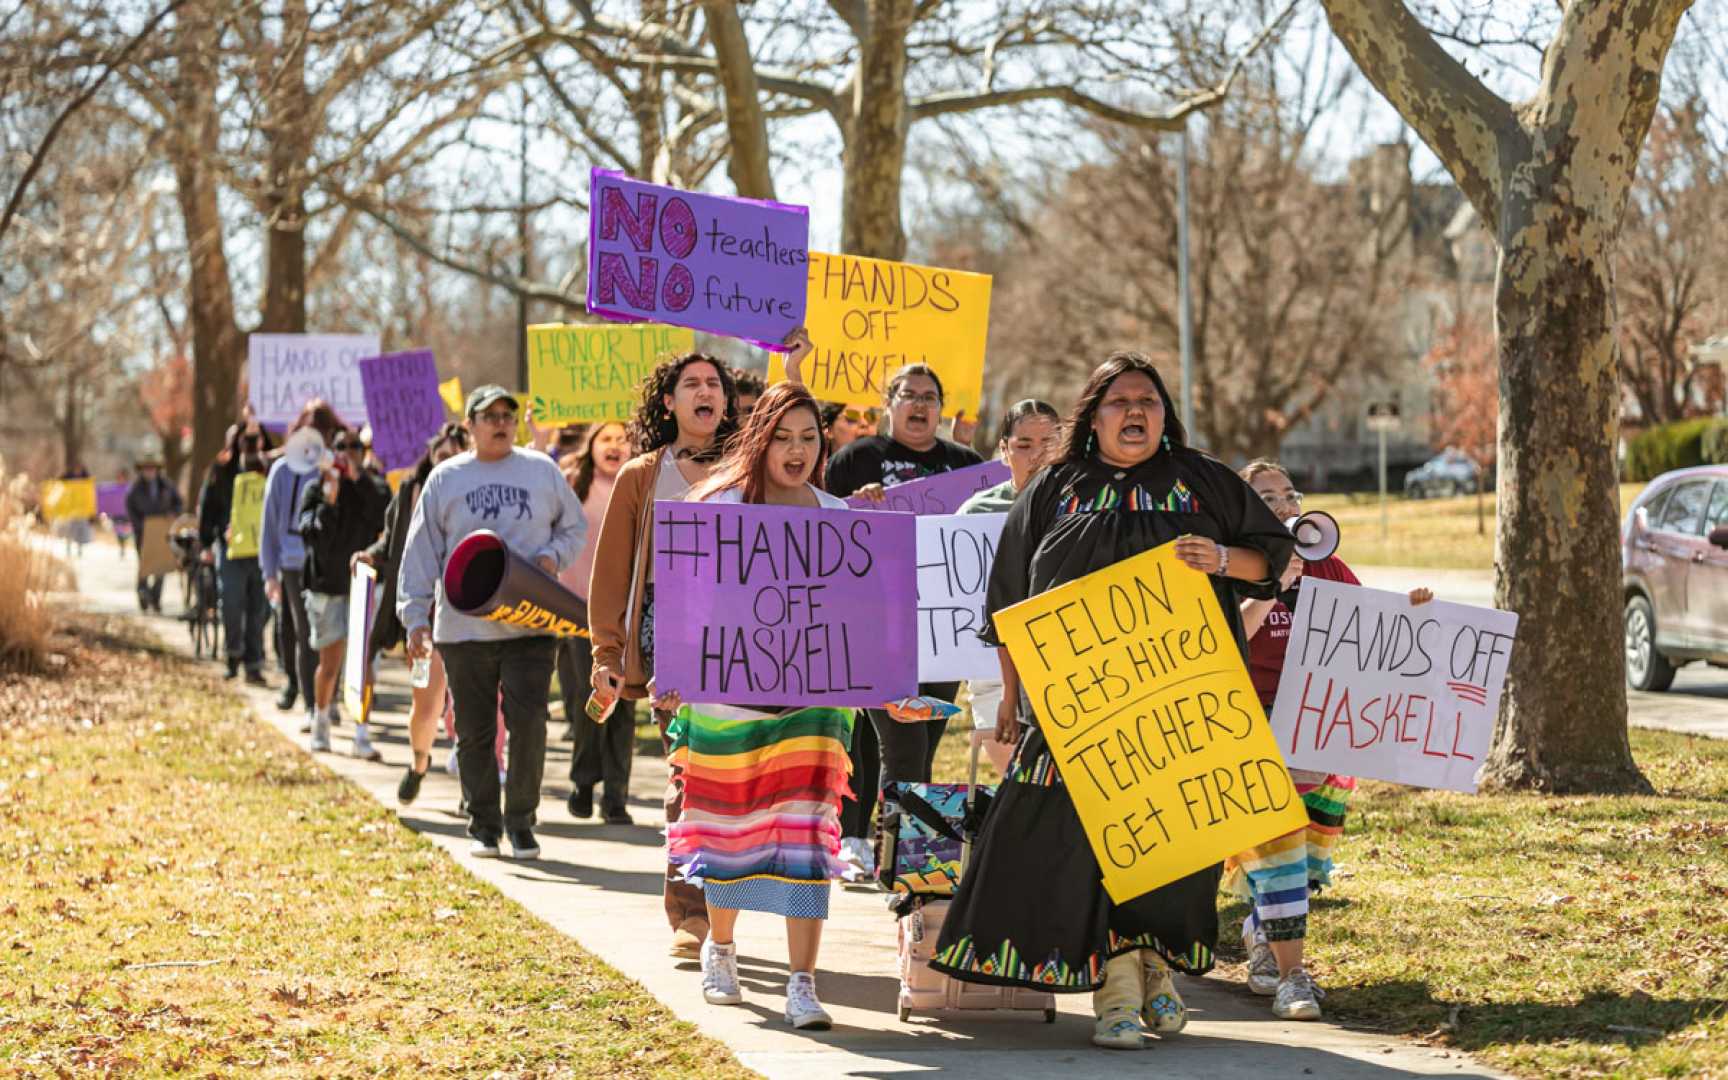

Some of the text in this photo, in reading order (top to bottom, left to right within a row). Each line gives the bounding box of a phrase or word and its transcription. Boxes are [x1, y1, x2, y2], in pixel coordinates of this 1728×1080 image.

[599, 186, 808, 266] NO teachers
[597, 251, 797, 319] NO future
[536, 329, 627, 367] HONOR
[842, 309, 899, 341] OFF
[811, 345, 927, 394] HASKE
[658, 510, 874, 585] #HANDS
[753, 585, 827, 627] OFF
[1025, 562, 1174, 671] FELON
[1126, 597, 1218, 683] Hired
[1300, 587, 1515, 687] HANDS OFF
[700, 622, 873, 696] HASKELL
[1067, 690, 1252, 801] TEACHERS
[1291, 671, 1475, 761] HASKELL
[1178, 758, 1292, 830] FIRED
